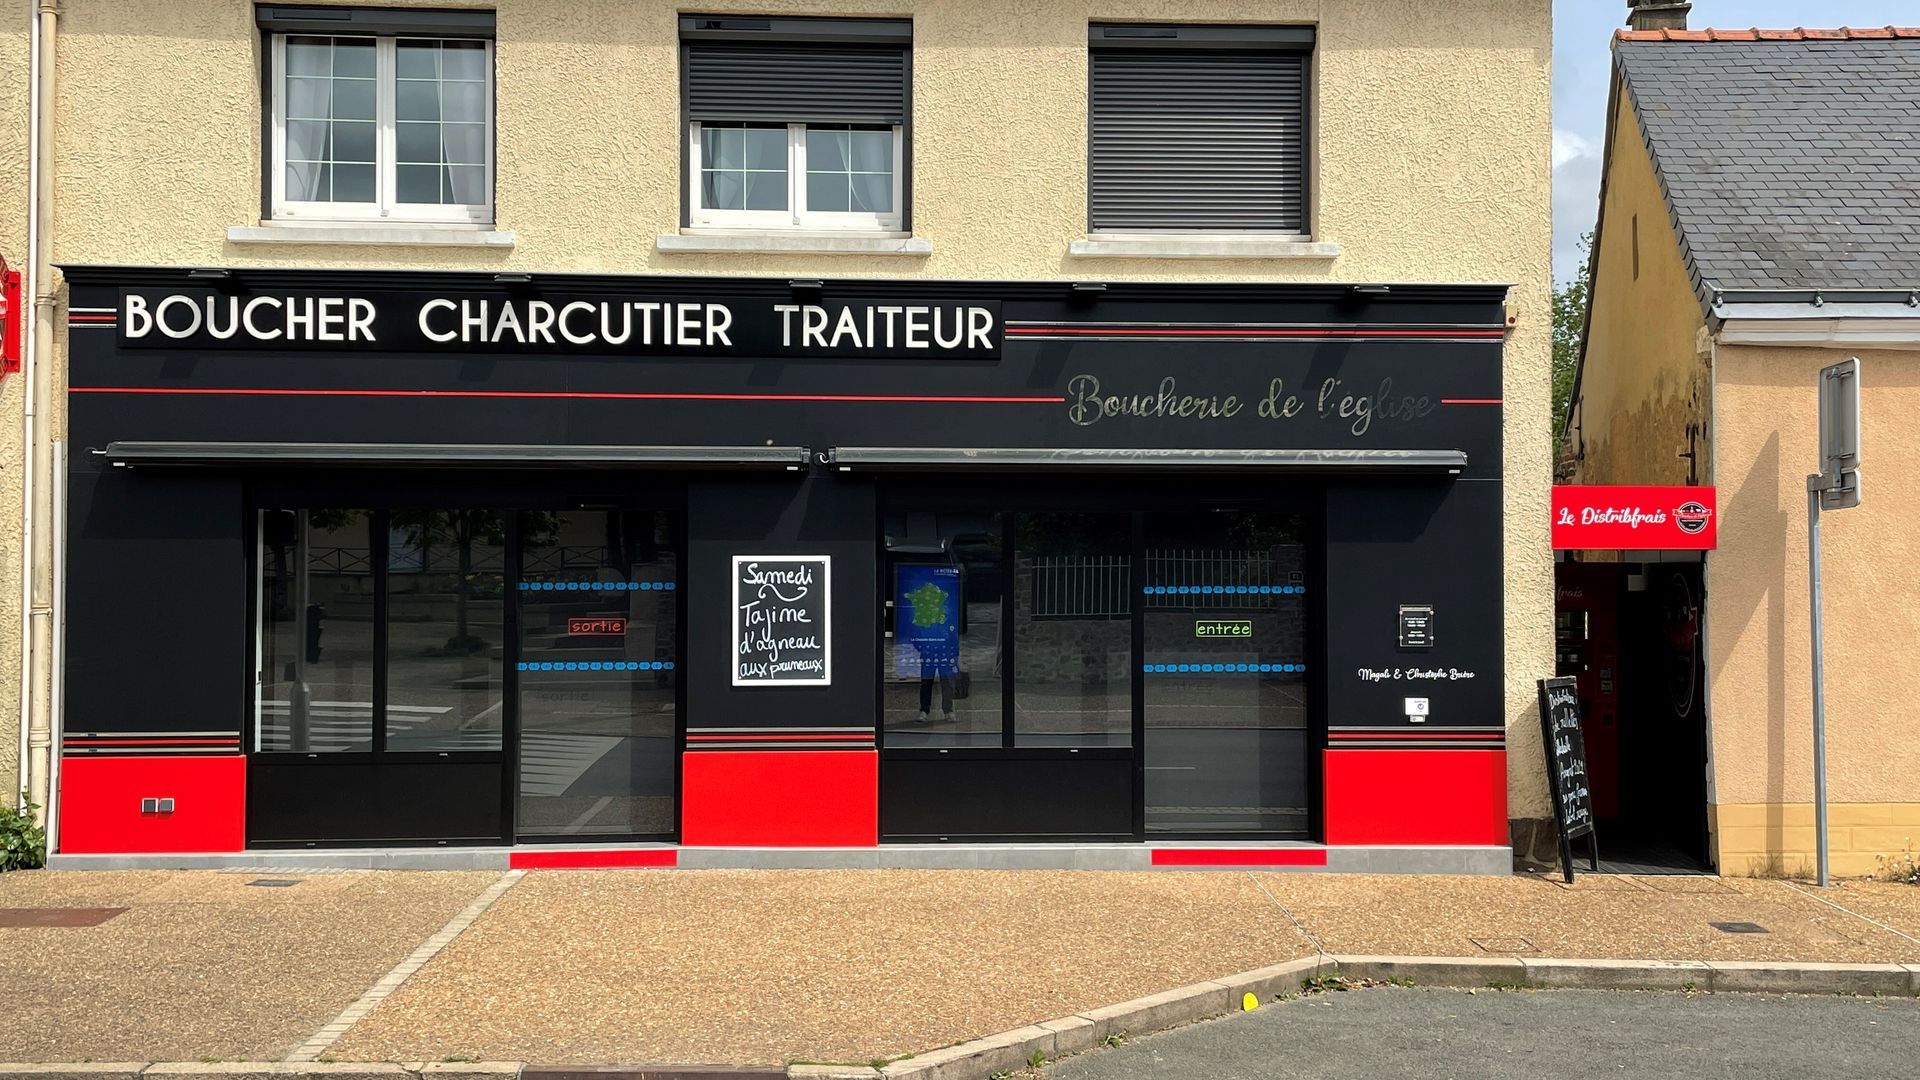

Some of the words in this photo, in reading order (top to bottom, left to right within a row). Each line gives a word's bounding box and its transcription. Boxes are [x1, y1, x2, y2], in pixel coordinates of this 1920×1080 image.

[125, 295, 376, 341] BOUCHER
[418, 299, 732, 347] CHARCUTIER
[774, 304, 993, 349] TRAITEUR
[1068, 374, 1243, 426] Boucherie
[1258, 377, 1303, 419] de
[1557, 508, 1575, 526] Le
[1581, 507, 1666, 528] Distribfrais
[743, 563, 812, 585] Samedi
[572, 620, 622, 632] sortie
[1197, 623, 1250, 635] entrée
[740, 631, 820, 661] d'agneau
[740, 662, 768, 677] aux
[770, 659, 823, 678] pruneaux
[1393, 669, 1402, 679] &
